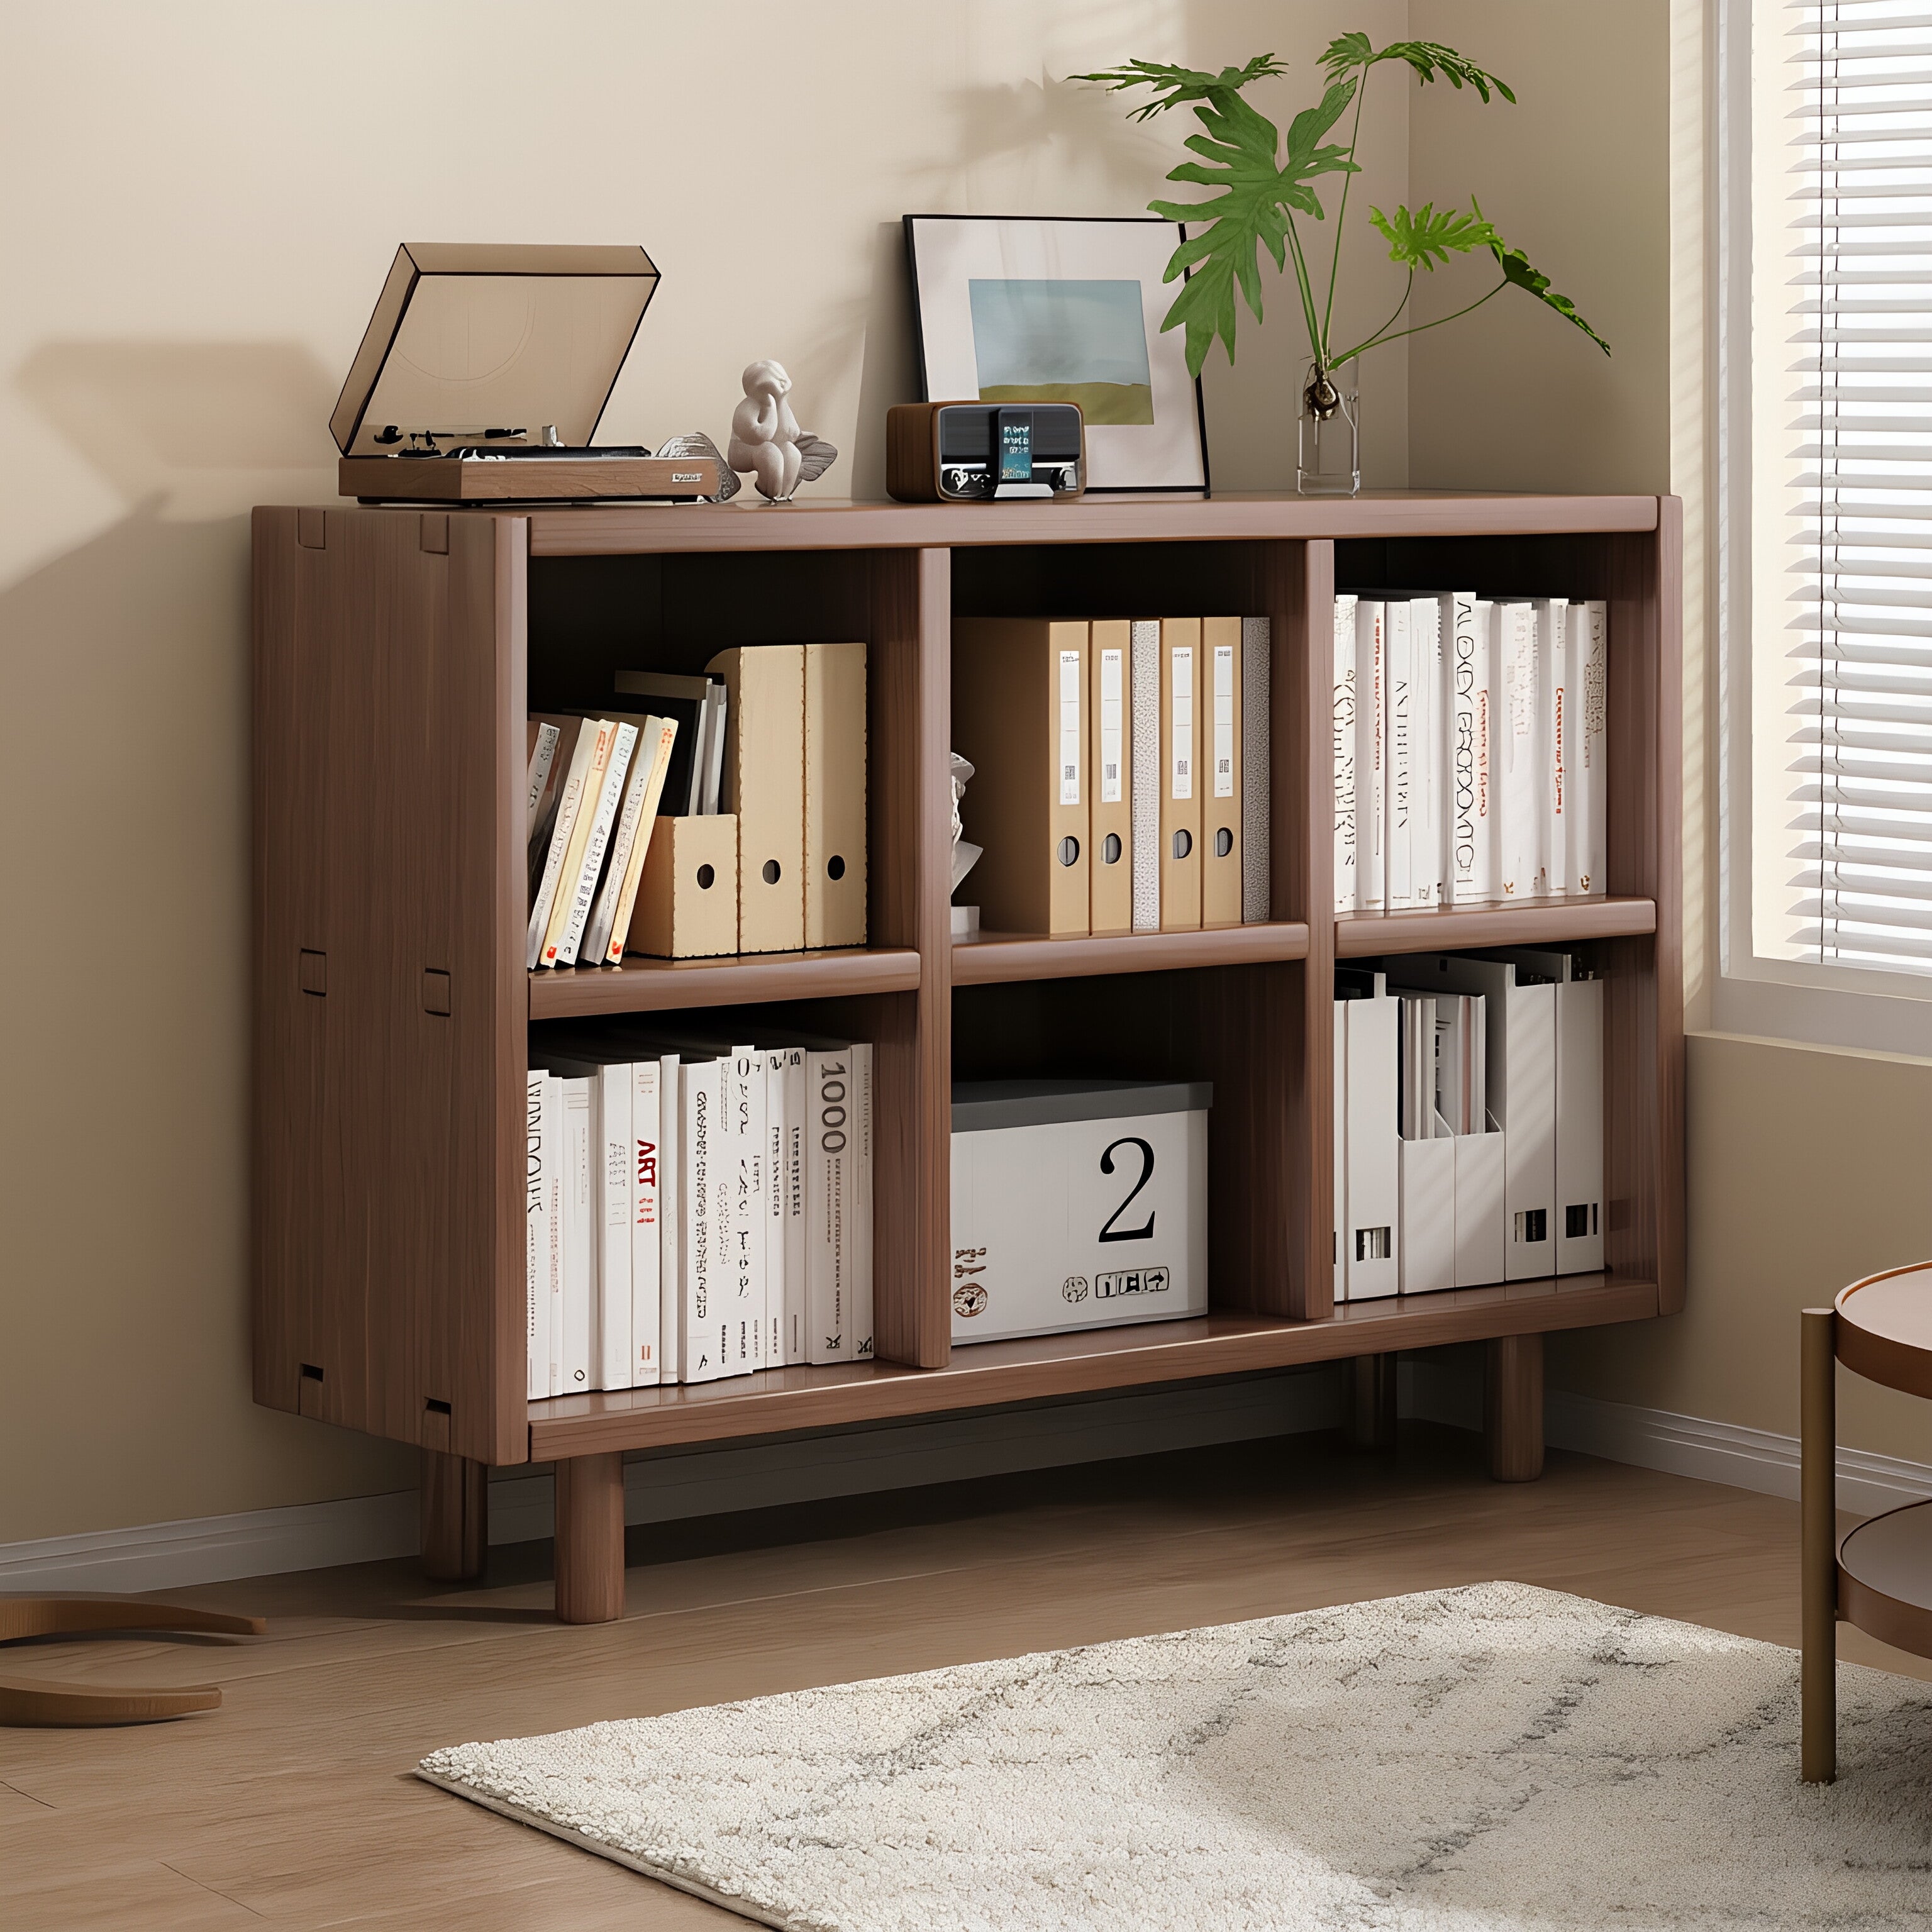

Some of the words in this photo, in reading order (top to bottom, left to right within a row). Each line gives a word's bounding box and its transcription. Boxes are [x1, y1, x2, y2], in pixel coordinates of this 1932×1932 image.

[821, 1062, 846, 1153] 1000
[637, 1140, 655, 1187] ART
[1099, 1137, 1155, 1242] 2
